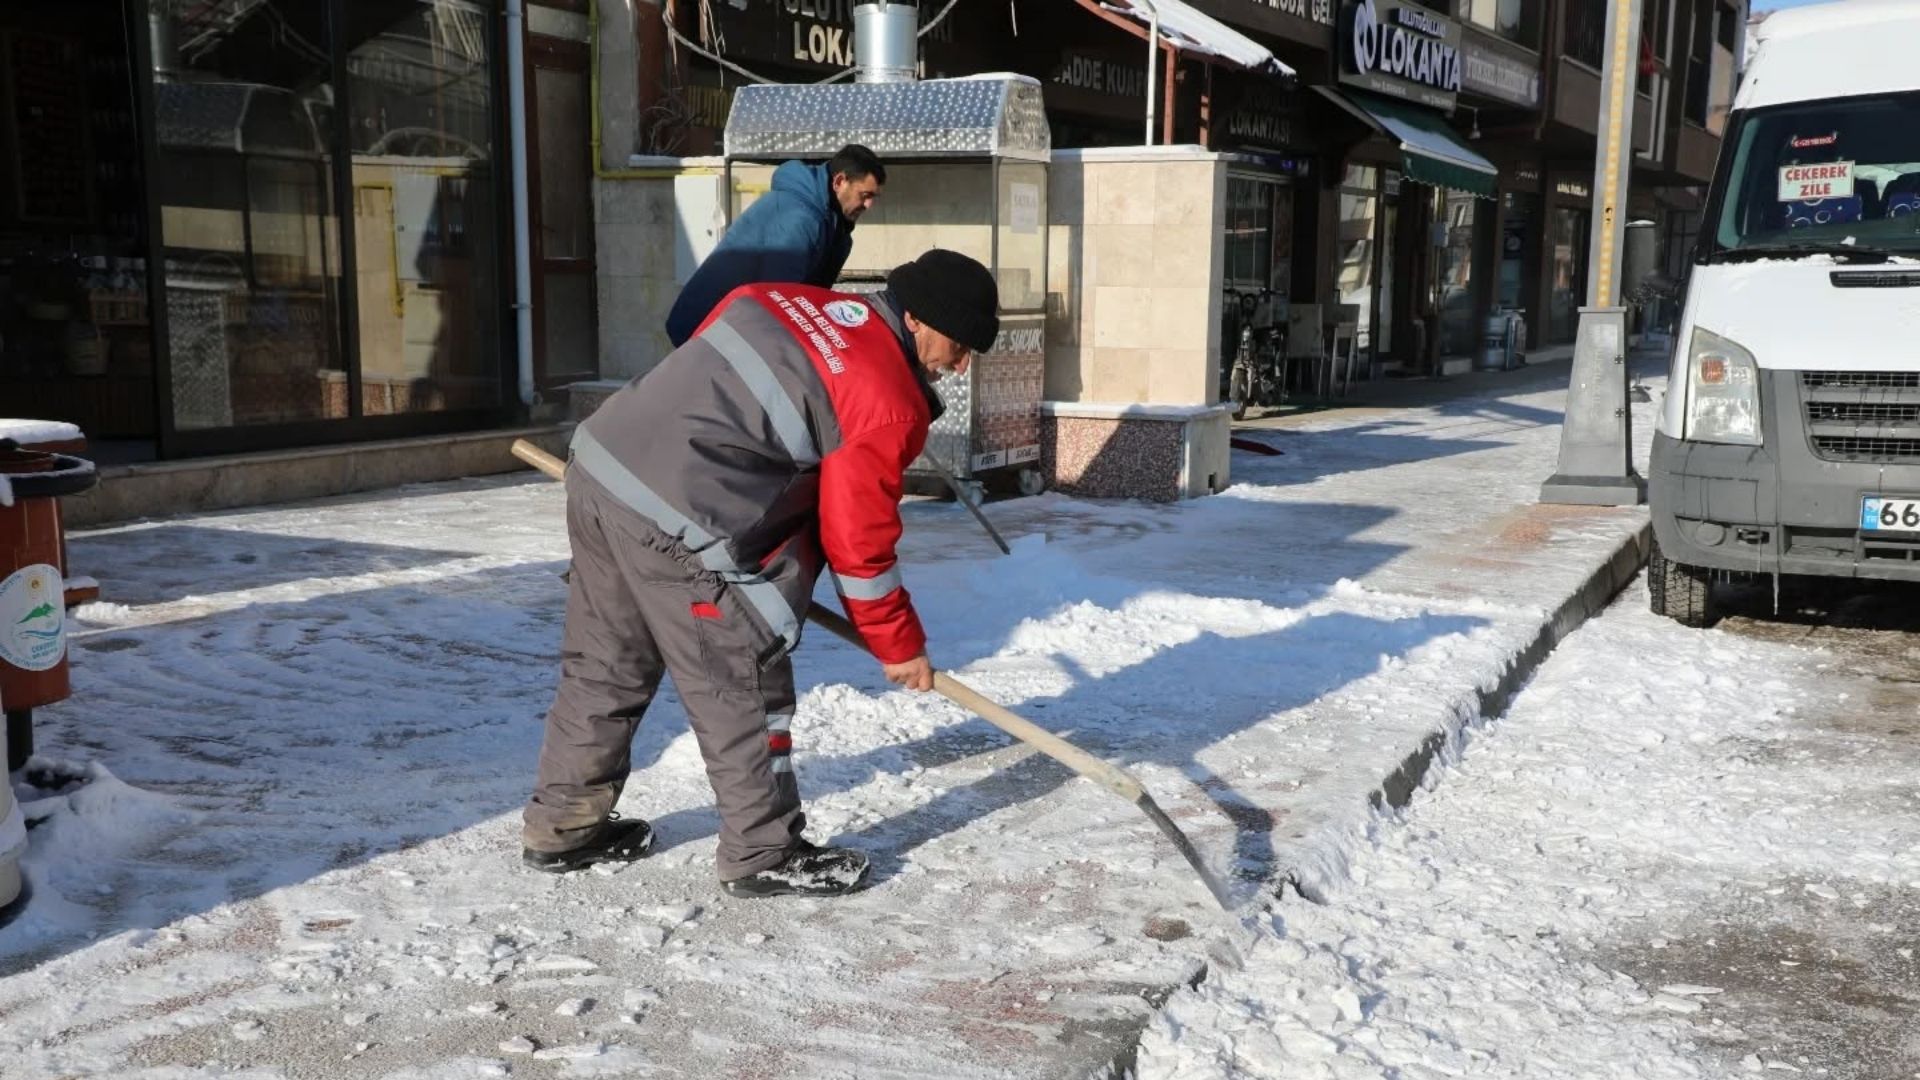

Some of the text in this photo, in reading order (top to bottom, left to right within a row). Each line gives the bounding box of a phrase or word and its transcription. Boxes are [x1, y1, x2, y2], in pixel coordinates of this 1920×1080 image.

[1053, 54, 1102, 90] ADDE
[1380, 23, 1460, 92] LOKANTA
[1785, 165, 1847, 184] ÇEKEREK
[1880, 502, 1920, 527] 66
